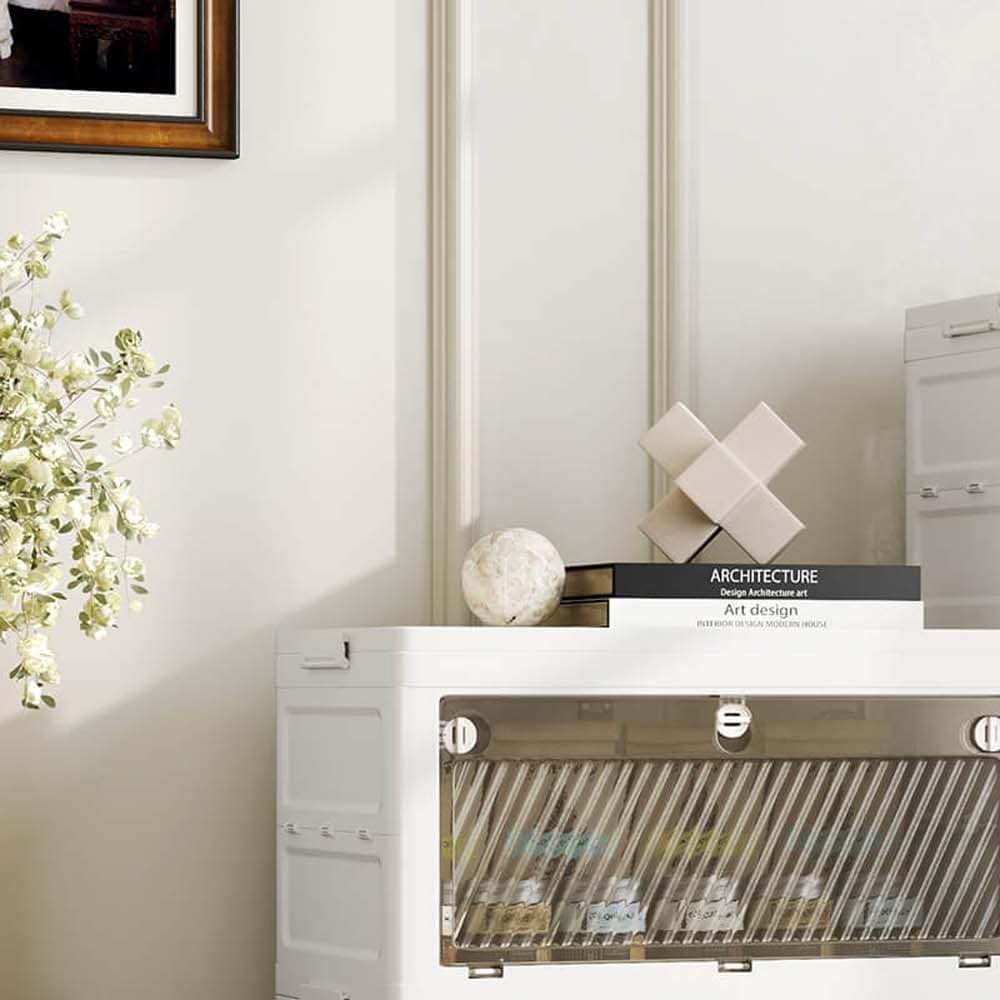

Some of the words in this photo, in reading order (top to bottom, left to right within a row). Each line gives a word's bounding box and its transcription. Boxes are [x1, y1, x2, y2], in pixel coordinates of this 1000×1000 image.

[710, 568, 818, 583] ARCHITECTURE
[720, 588, 746, 598] Design
[748, 588, 794, 598] Architecture
[796, 589, 808, 597] art
[724, 604, 746, 616] Art
[750, 604, 798, 619] design
[801, 620, 827, 628] HOUSE
